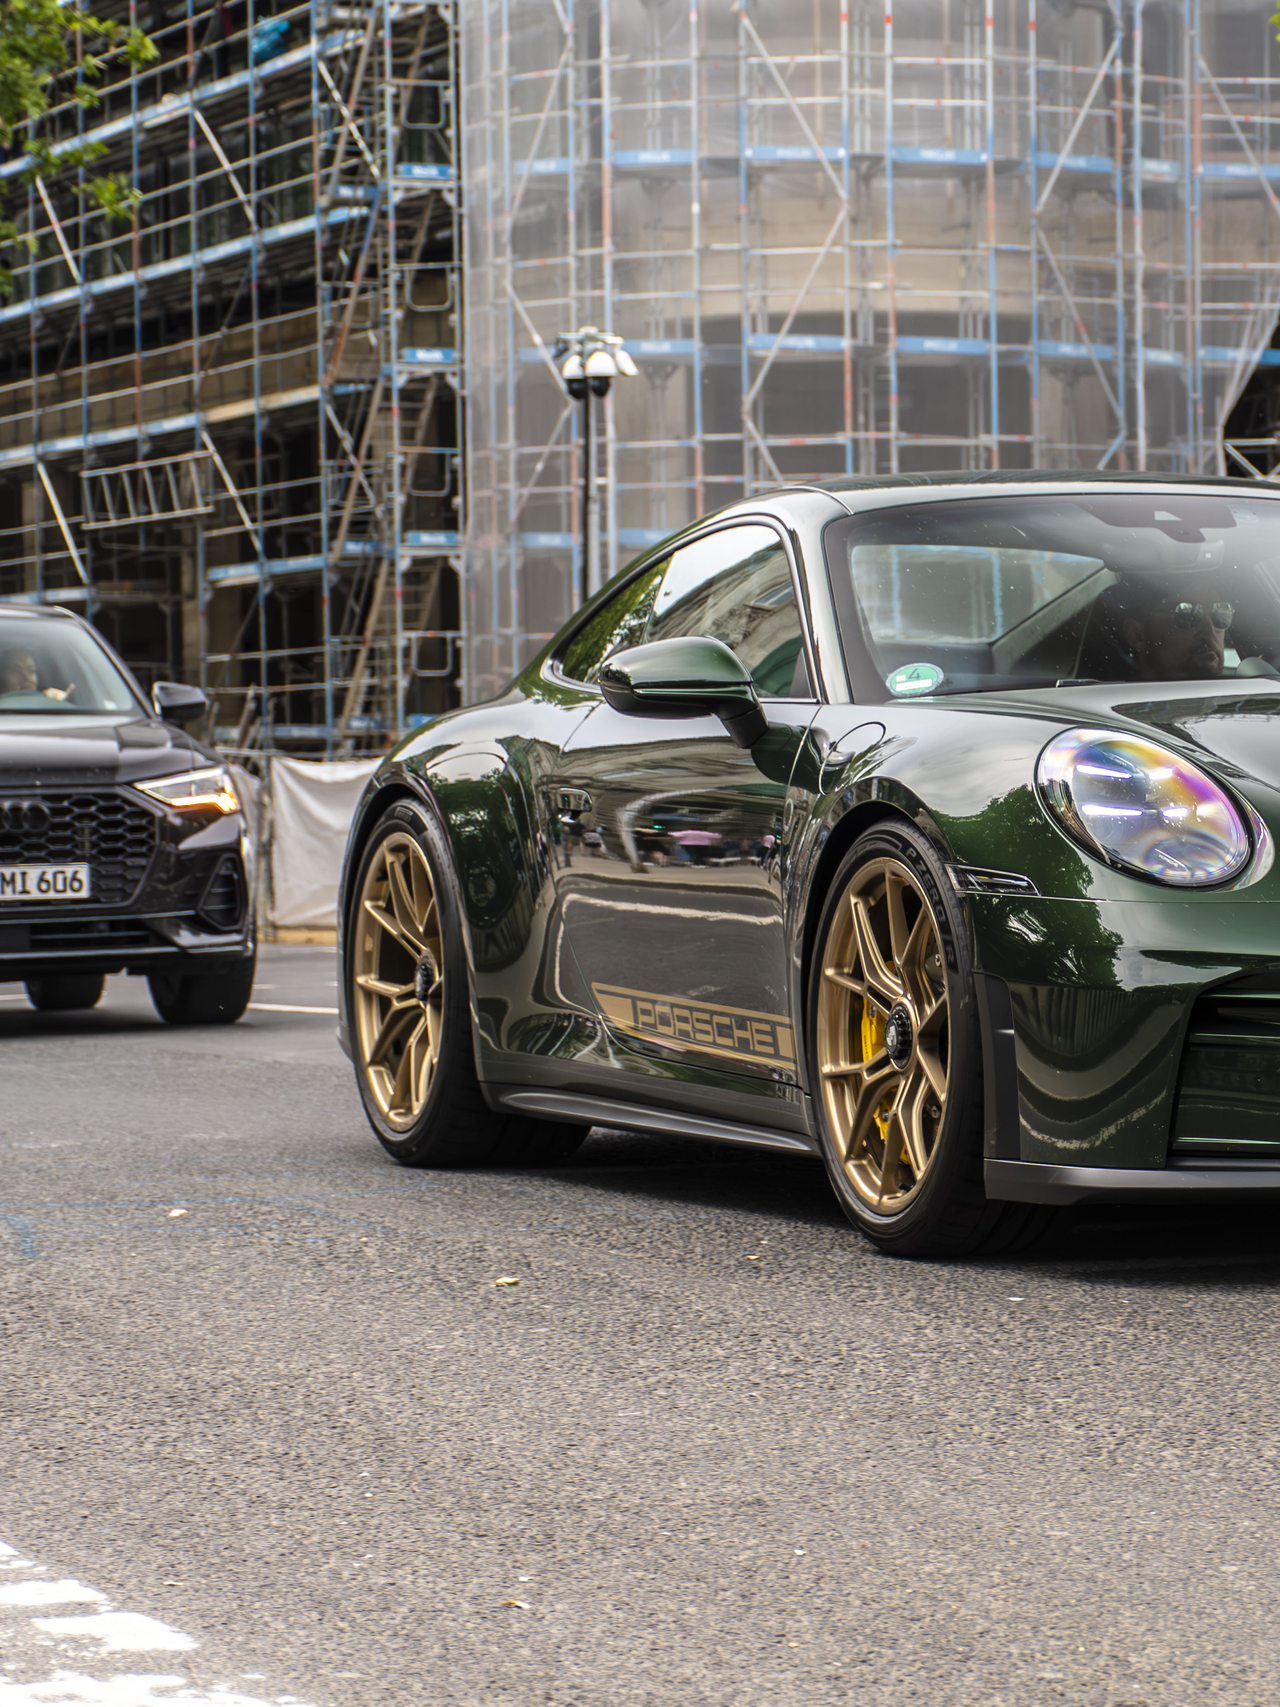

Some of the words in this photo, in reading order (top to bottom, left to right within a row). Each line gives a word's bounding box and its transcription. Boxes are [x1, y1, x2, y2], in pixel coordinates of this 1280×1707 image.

[908, 668, 921, 680] 4
[37, 870, 84, 893] 606
[636, 1000, 775, 1054] PORSCHE
